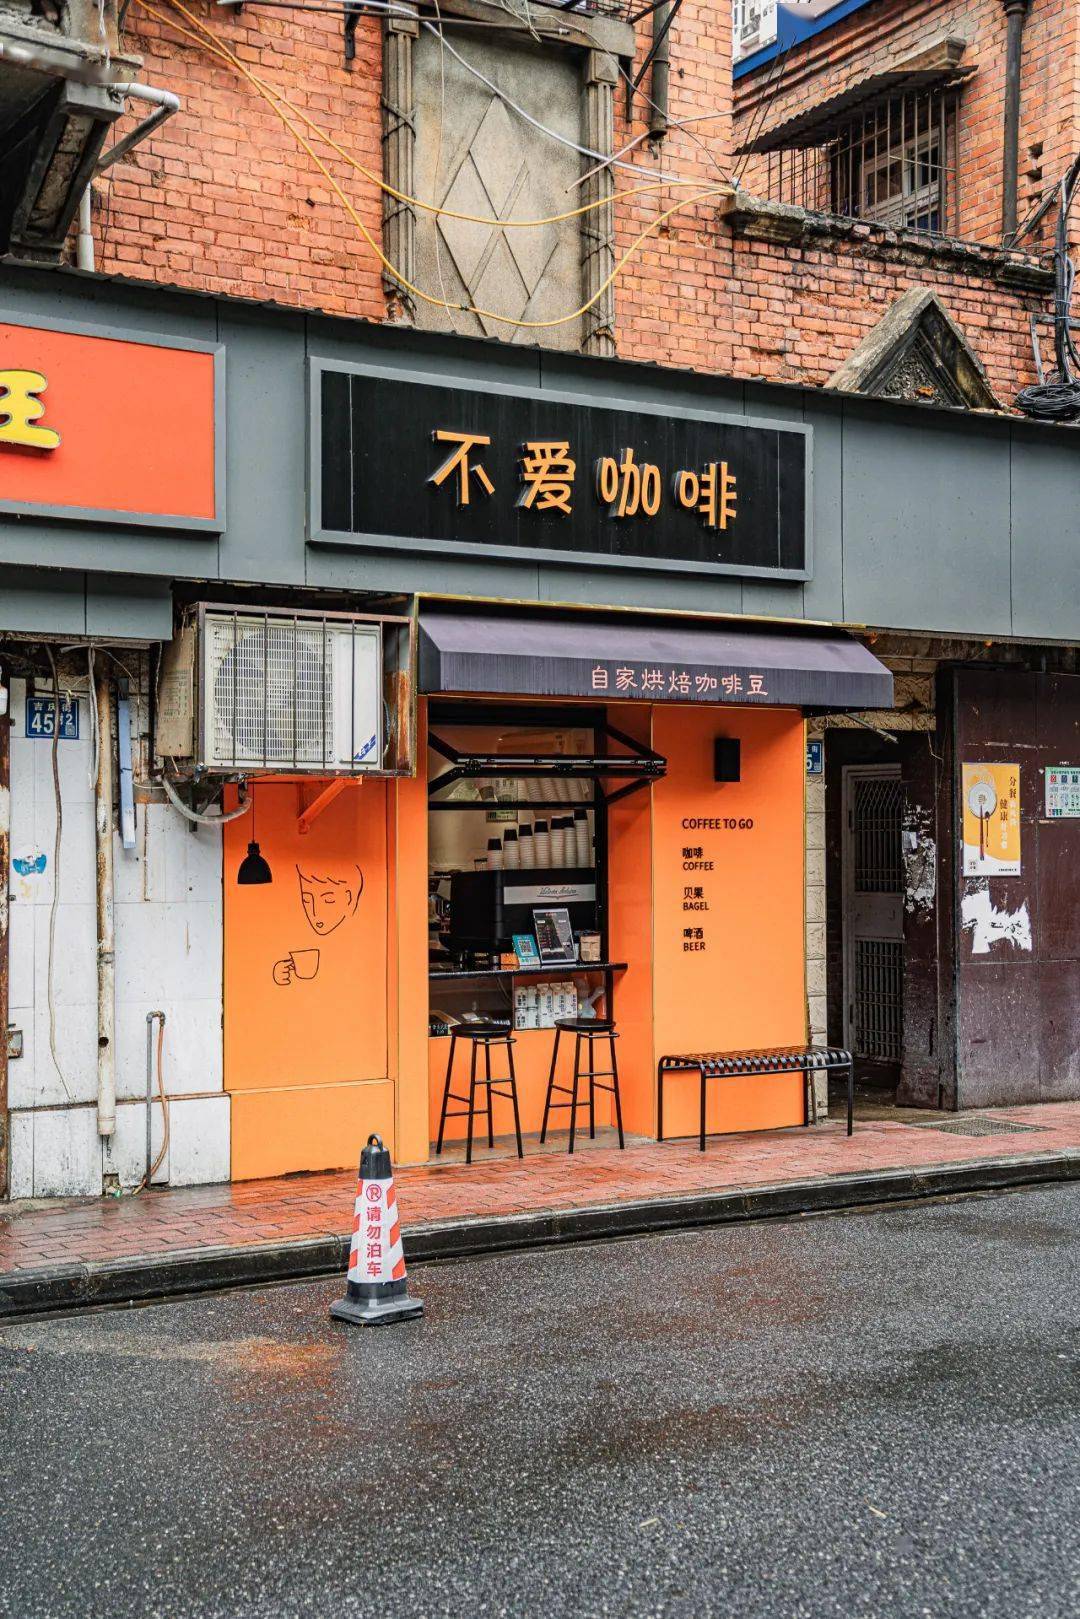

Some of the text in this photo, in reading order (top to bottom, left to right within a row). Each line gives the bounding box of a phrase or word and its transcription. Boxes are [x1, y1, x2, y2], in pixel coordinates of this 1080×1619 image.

[428, 430, 738, 530] 不爱咖啡
[591, 665, 769, 697] 自家烘焙咖啡豆
[682, 818, 754, 830] COFFEE TO GO
[682, 847, 704, 859] 咖啡
[682, 861, 715, 871] COFFEE
[684, 886, 704, 900] 贝果
[683, 901, 710, 911] BAGEL
[683, 927, 704, 940] 啤酒
[683, 941, 706, 952] BEER
[366, 1206, 382, 1277] 请勿泊车
